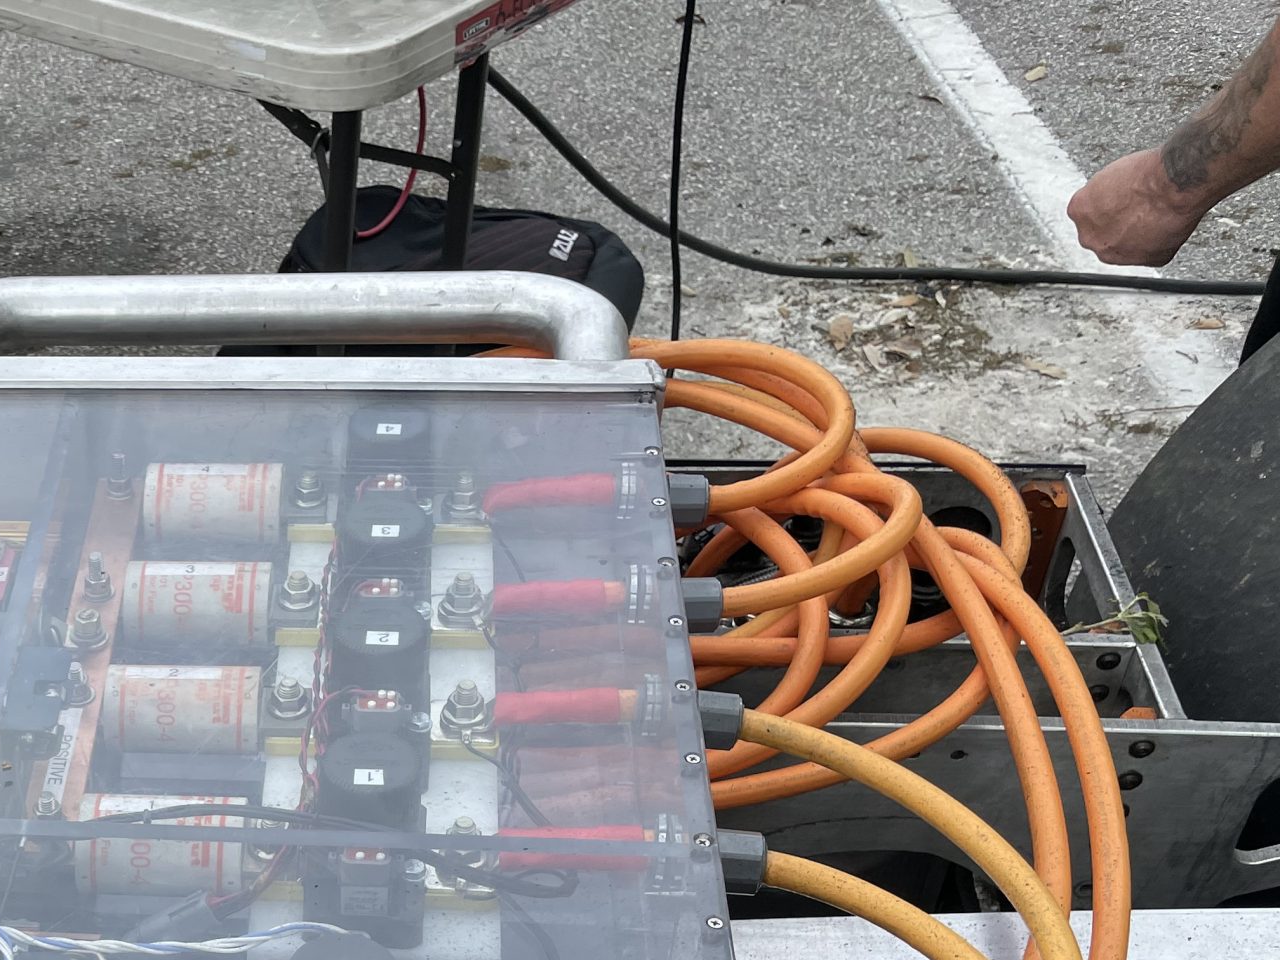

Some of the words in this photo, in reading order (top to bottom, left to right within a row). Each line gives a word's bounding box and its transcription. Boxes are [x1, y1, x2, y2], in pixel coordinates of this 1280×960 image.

[381, 526, 391, 536] 3
[185, 564, 196, 574] 3
[378, 633, 390, 643] 2
[169, 669, 179, 678] 2
[46, 735, 72, 785] POSITIVE
